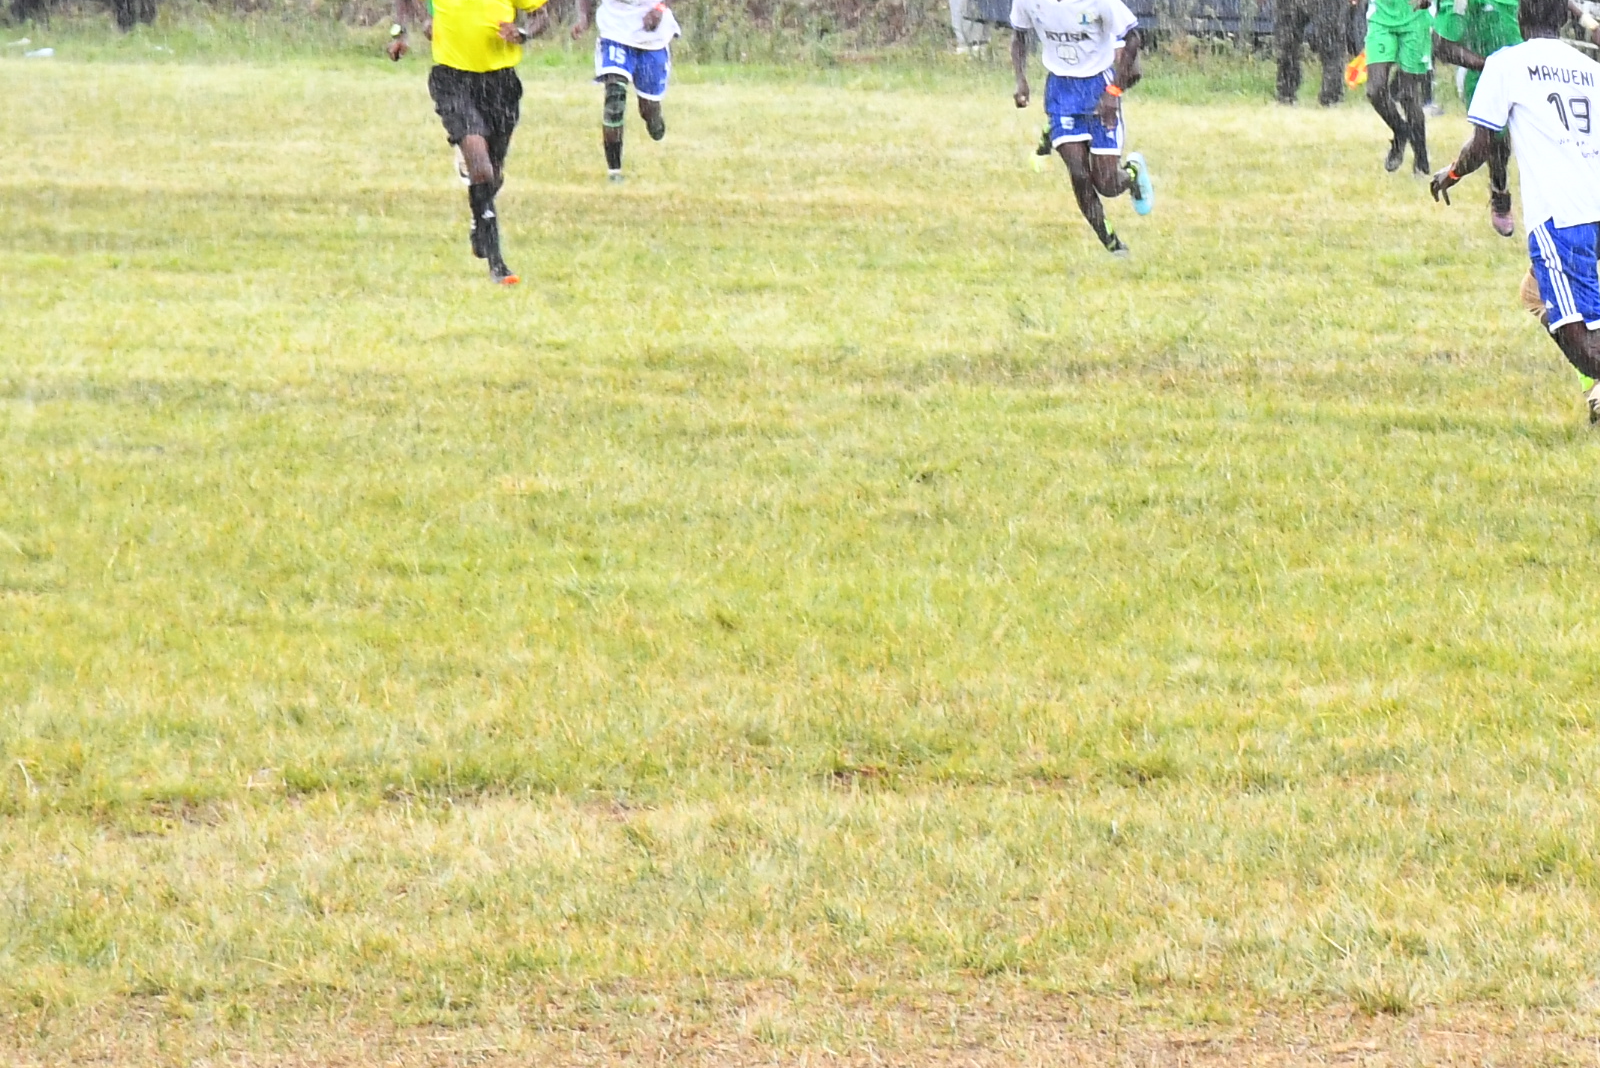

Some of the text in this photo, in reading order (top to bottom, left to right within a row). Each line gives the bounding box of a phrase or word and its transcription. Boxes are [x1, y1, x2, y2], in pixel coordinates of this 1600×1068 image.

[608, 45, 627, 65] 15
[1527, 65, 1594, 87] MAKUENI
[1547, 92, 1591, 135] 19
